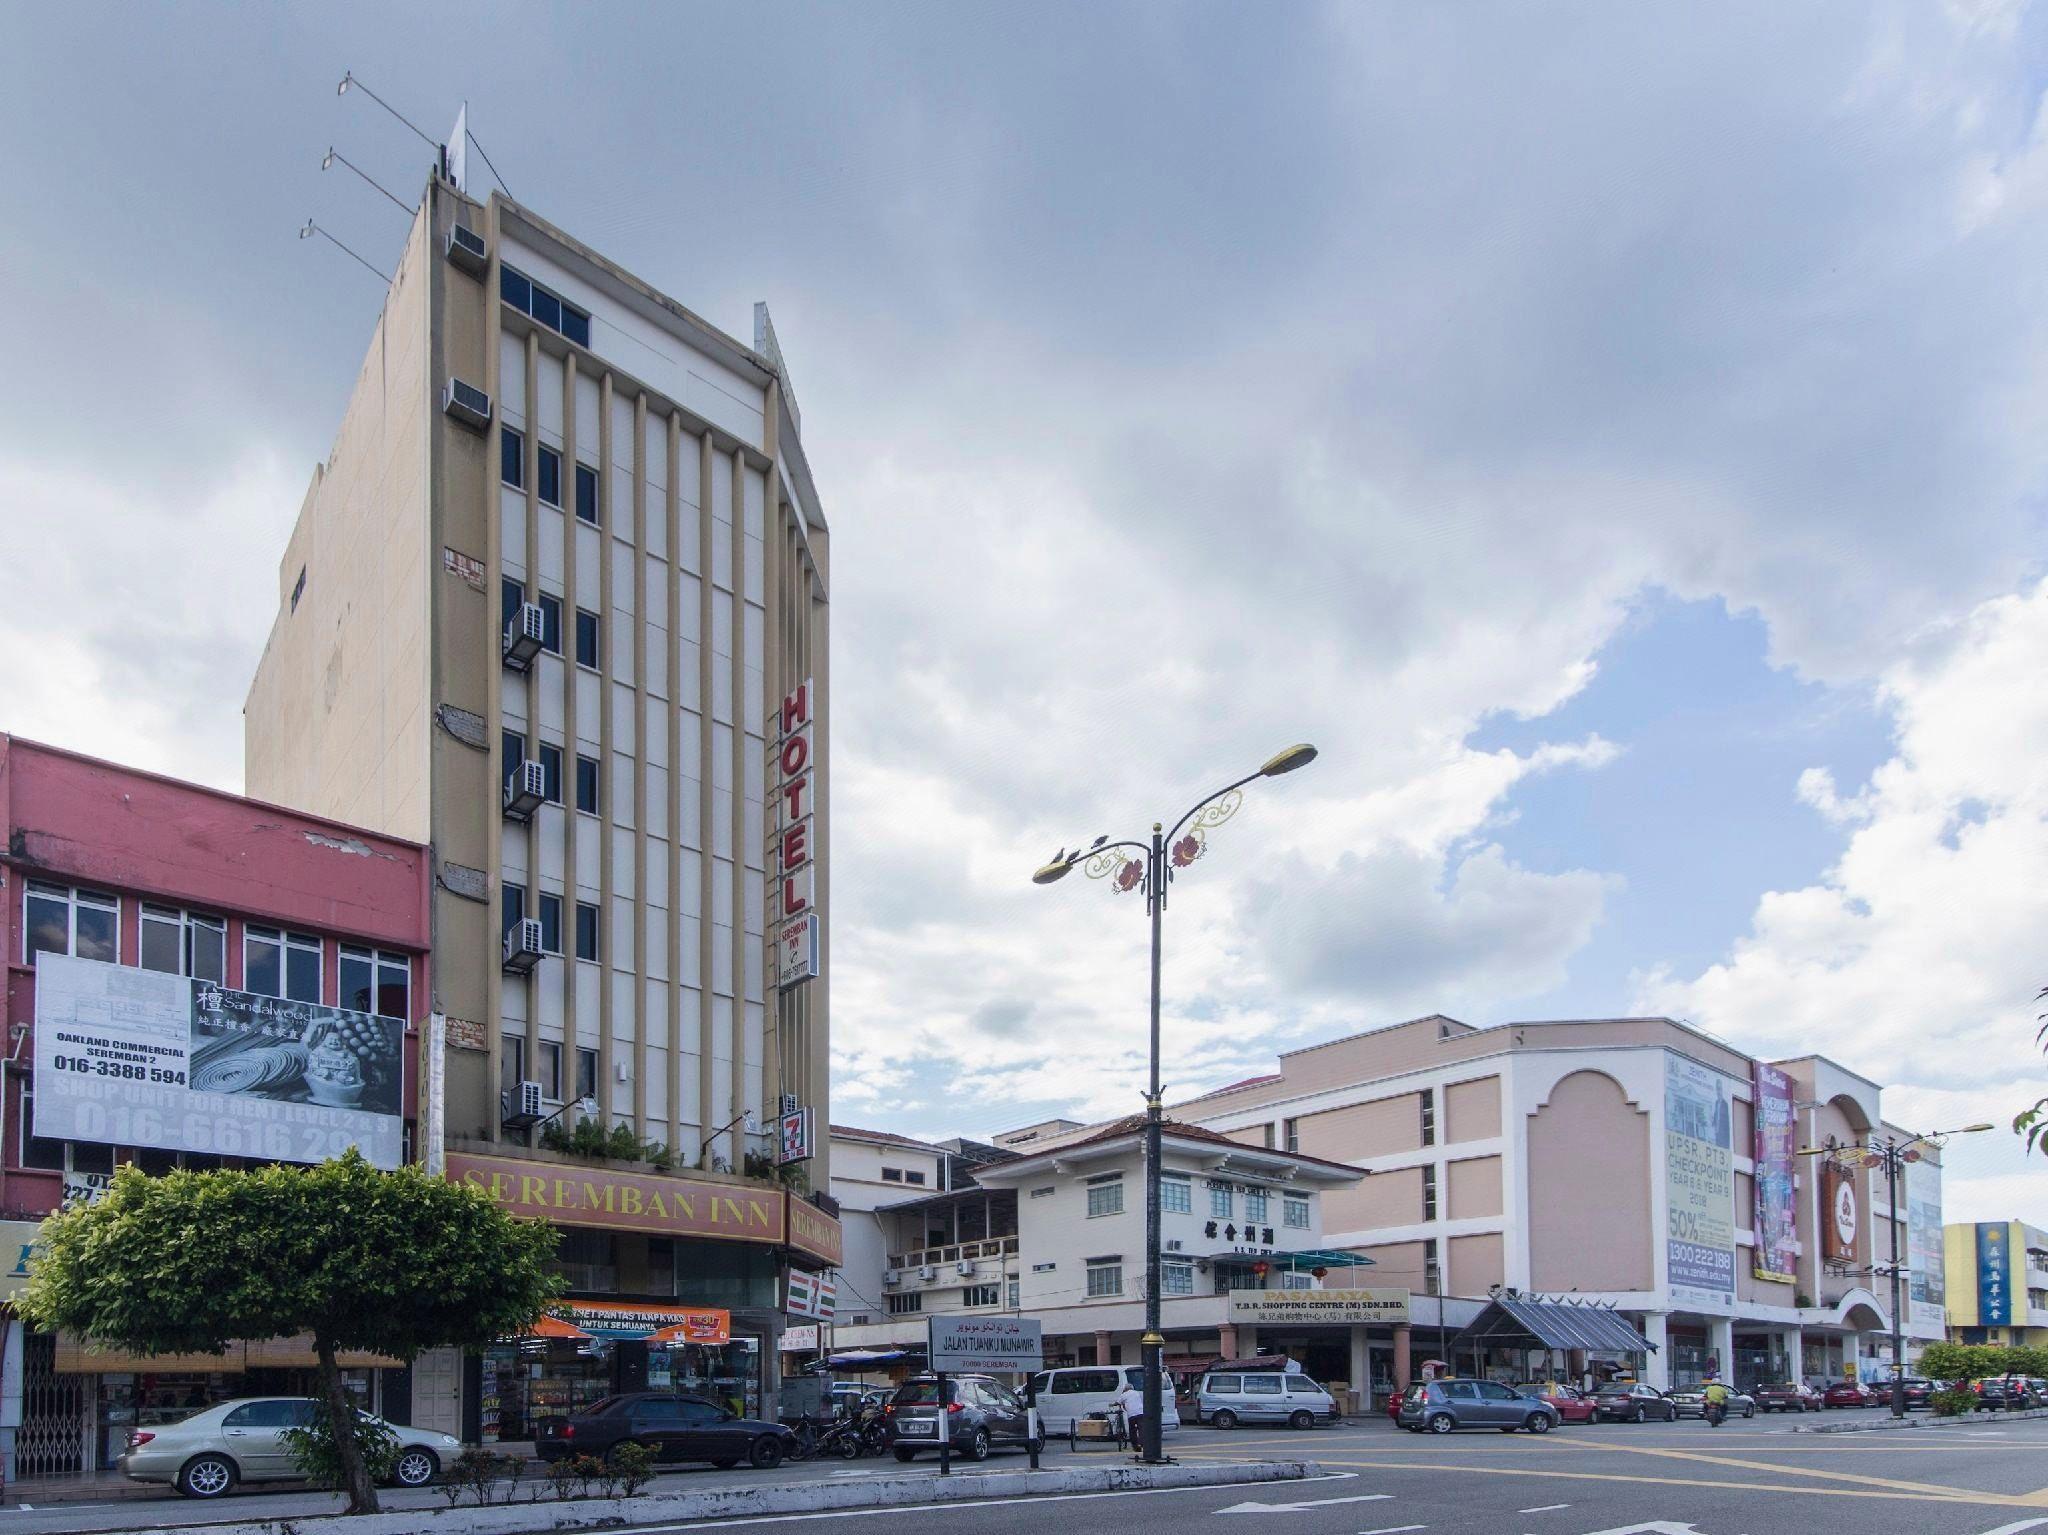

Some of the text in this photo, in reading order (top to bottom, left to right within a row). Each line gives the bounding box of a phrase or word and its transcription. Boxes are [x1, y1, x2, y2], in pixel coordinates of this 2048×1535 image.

[782, 685, 807, 914] HOTEL
[782, 920, 808, 942] SEREMBAN
[789, 937, 799, 951] INN
[224, 999, 313, 1022] Sandalwood
[57, 1032, 185, 1058] OAKLAND COMMERCIAL
[87, 1048, 157, 1065] SEREMBAN 2
[55, 1055, 186, 1085] 016-3388 594
[54, 1077, 120, 1102] SHOP
[124, 1086, 178, 1108] UNIT
[232, 1100, 281, 1120] RENT
[285, 1106, 339, 1128] LEVEL
[343, 1113, 355, 1129] 2
[75, 1101, 292, 1154] 016-6616
[785, 1117, 800, 1150] 7
[1668, 1154, 1729, 1183] CHECKPOINT
[464, 1168, 770, 1228] SEREMBAN INN
[1704, 1181, 1722, 1195] YEAR
[792, 1209, 841, 1252] SEREMBAN INN
[1669, 1207, 1699, 1241] 50%
[1670, 1243, 1731, 1270] 1300 222 188
[811, 1279, 820, 1315] 7
[1262, 1302, 1307, 1310] SHOPPING
[1309, 1302, 1344, 1310] CENTRE
[1345, 1302, 1361, 1311] (M)
[1264, 1291, 1374, 1301] PASARAYA
[579, 1319, 656, 1331] UNTUK SEMUANYA
[598, 1310, 634, 1321] PANTAS
[637, 1312, 666, 1322] TANPA
[667, 1313, 685, 1324] HAD
[943, 1335, 1035, 1353] JALAN TUANKU MUNAWIR
[983, 1361, 1018, 1369] SEREMBAN
